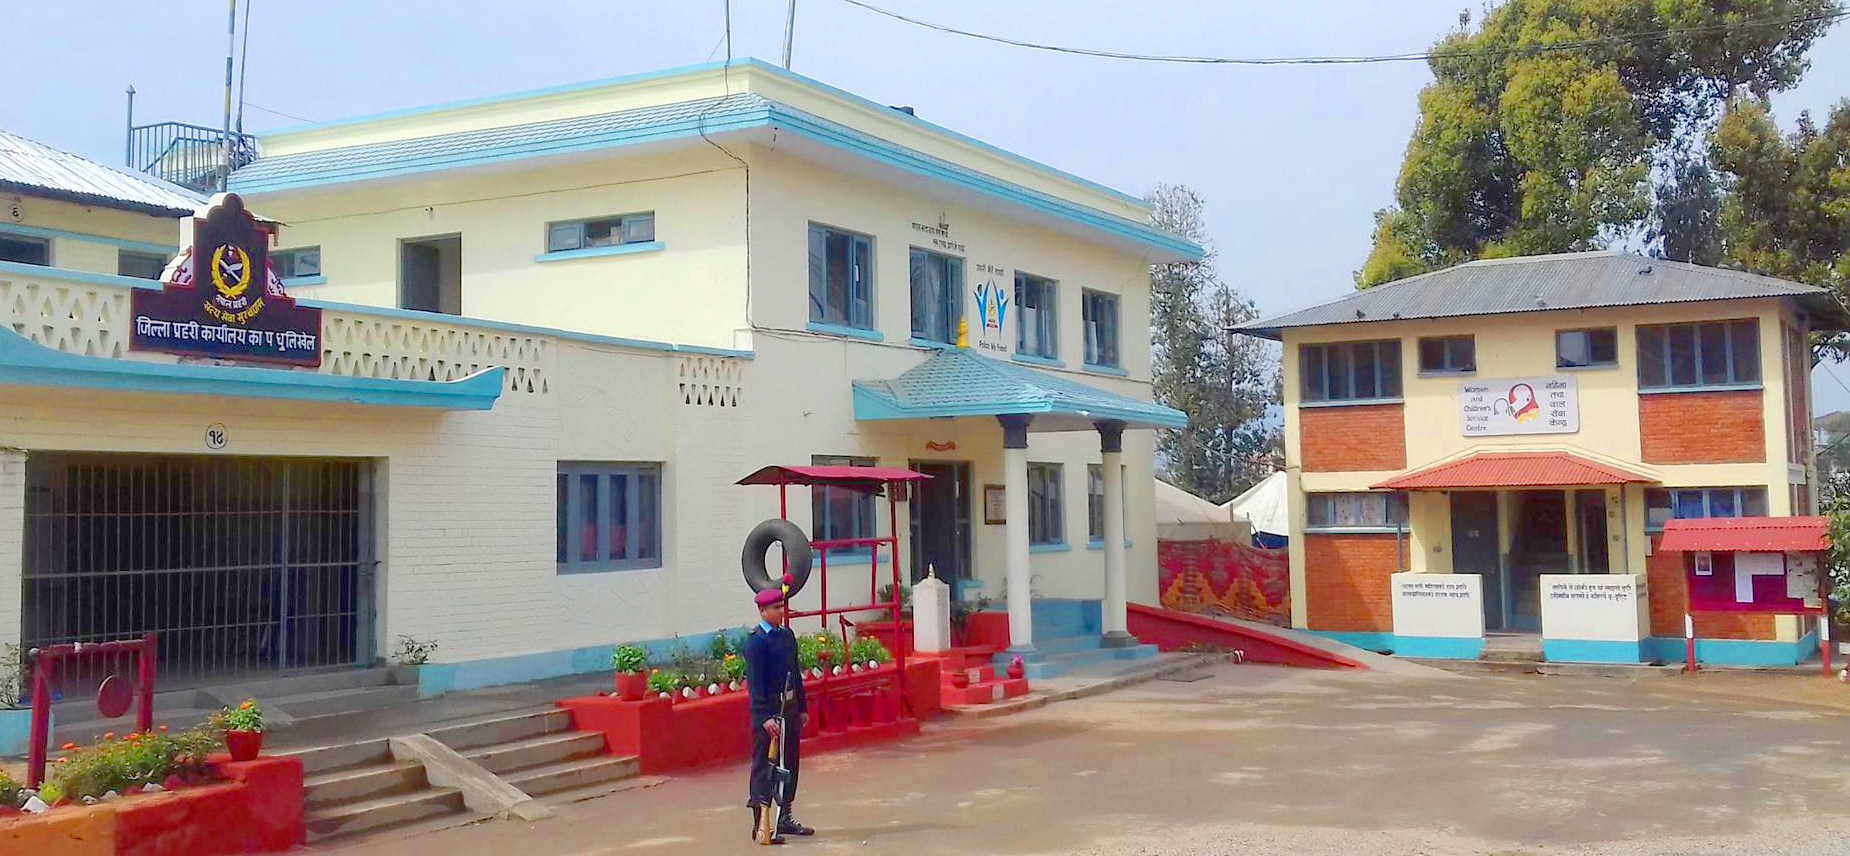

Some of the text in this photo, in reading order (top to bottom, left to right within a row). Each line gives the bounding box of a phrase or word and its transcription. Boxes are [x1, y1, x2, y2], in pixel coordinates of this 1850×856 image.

[204, 300, 222, 319] सत्य
[221, 311, 236, 324] सेवा
[136, 316, 316, 352] जिल्ला प्रहरी कार्यालय का प धुलिखेल
[1467, 414, 1489, 422] Service
[1466, 424, 1487, 432] Centre
